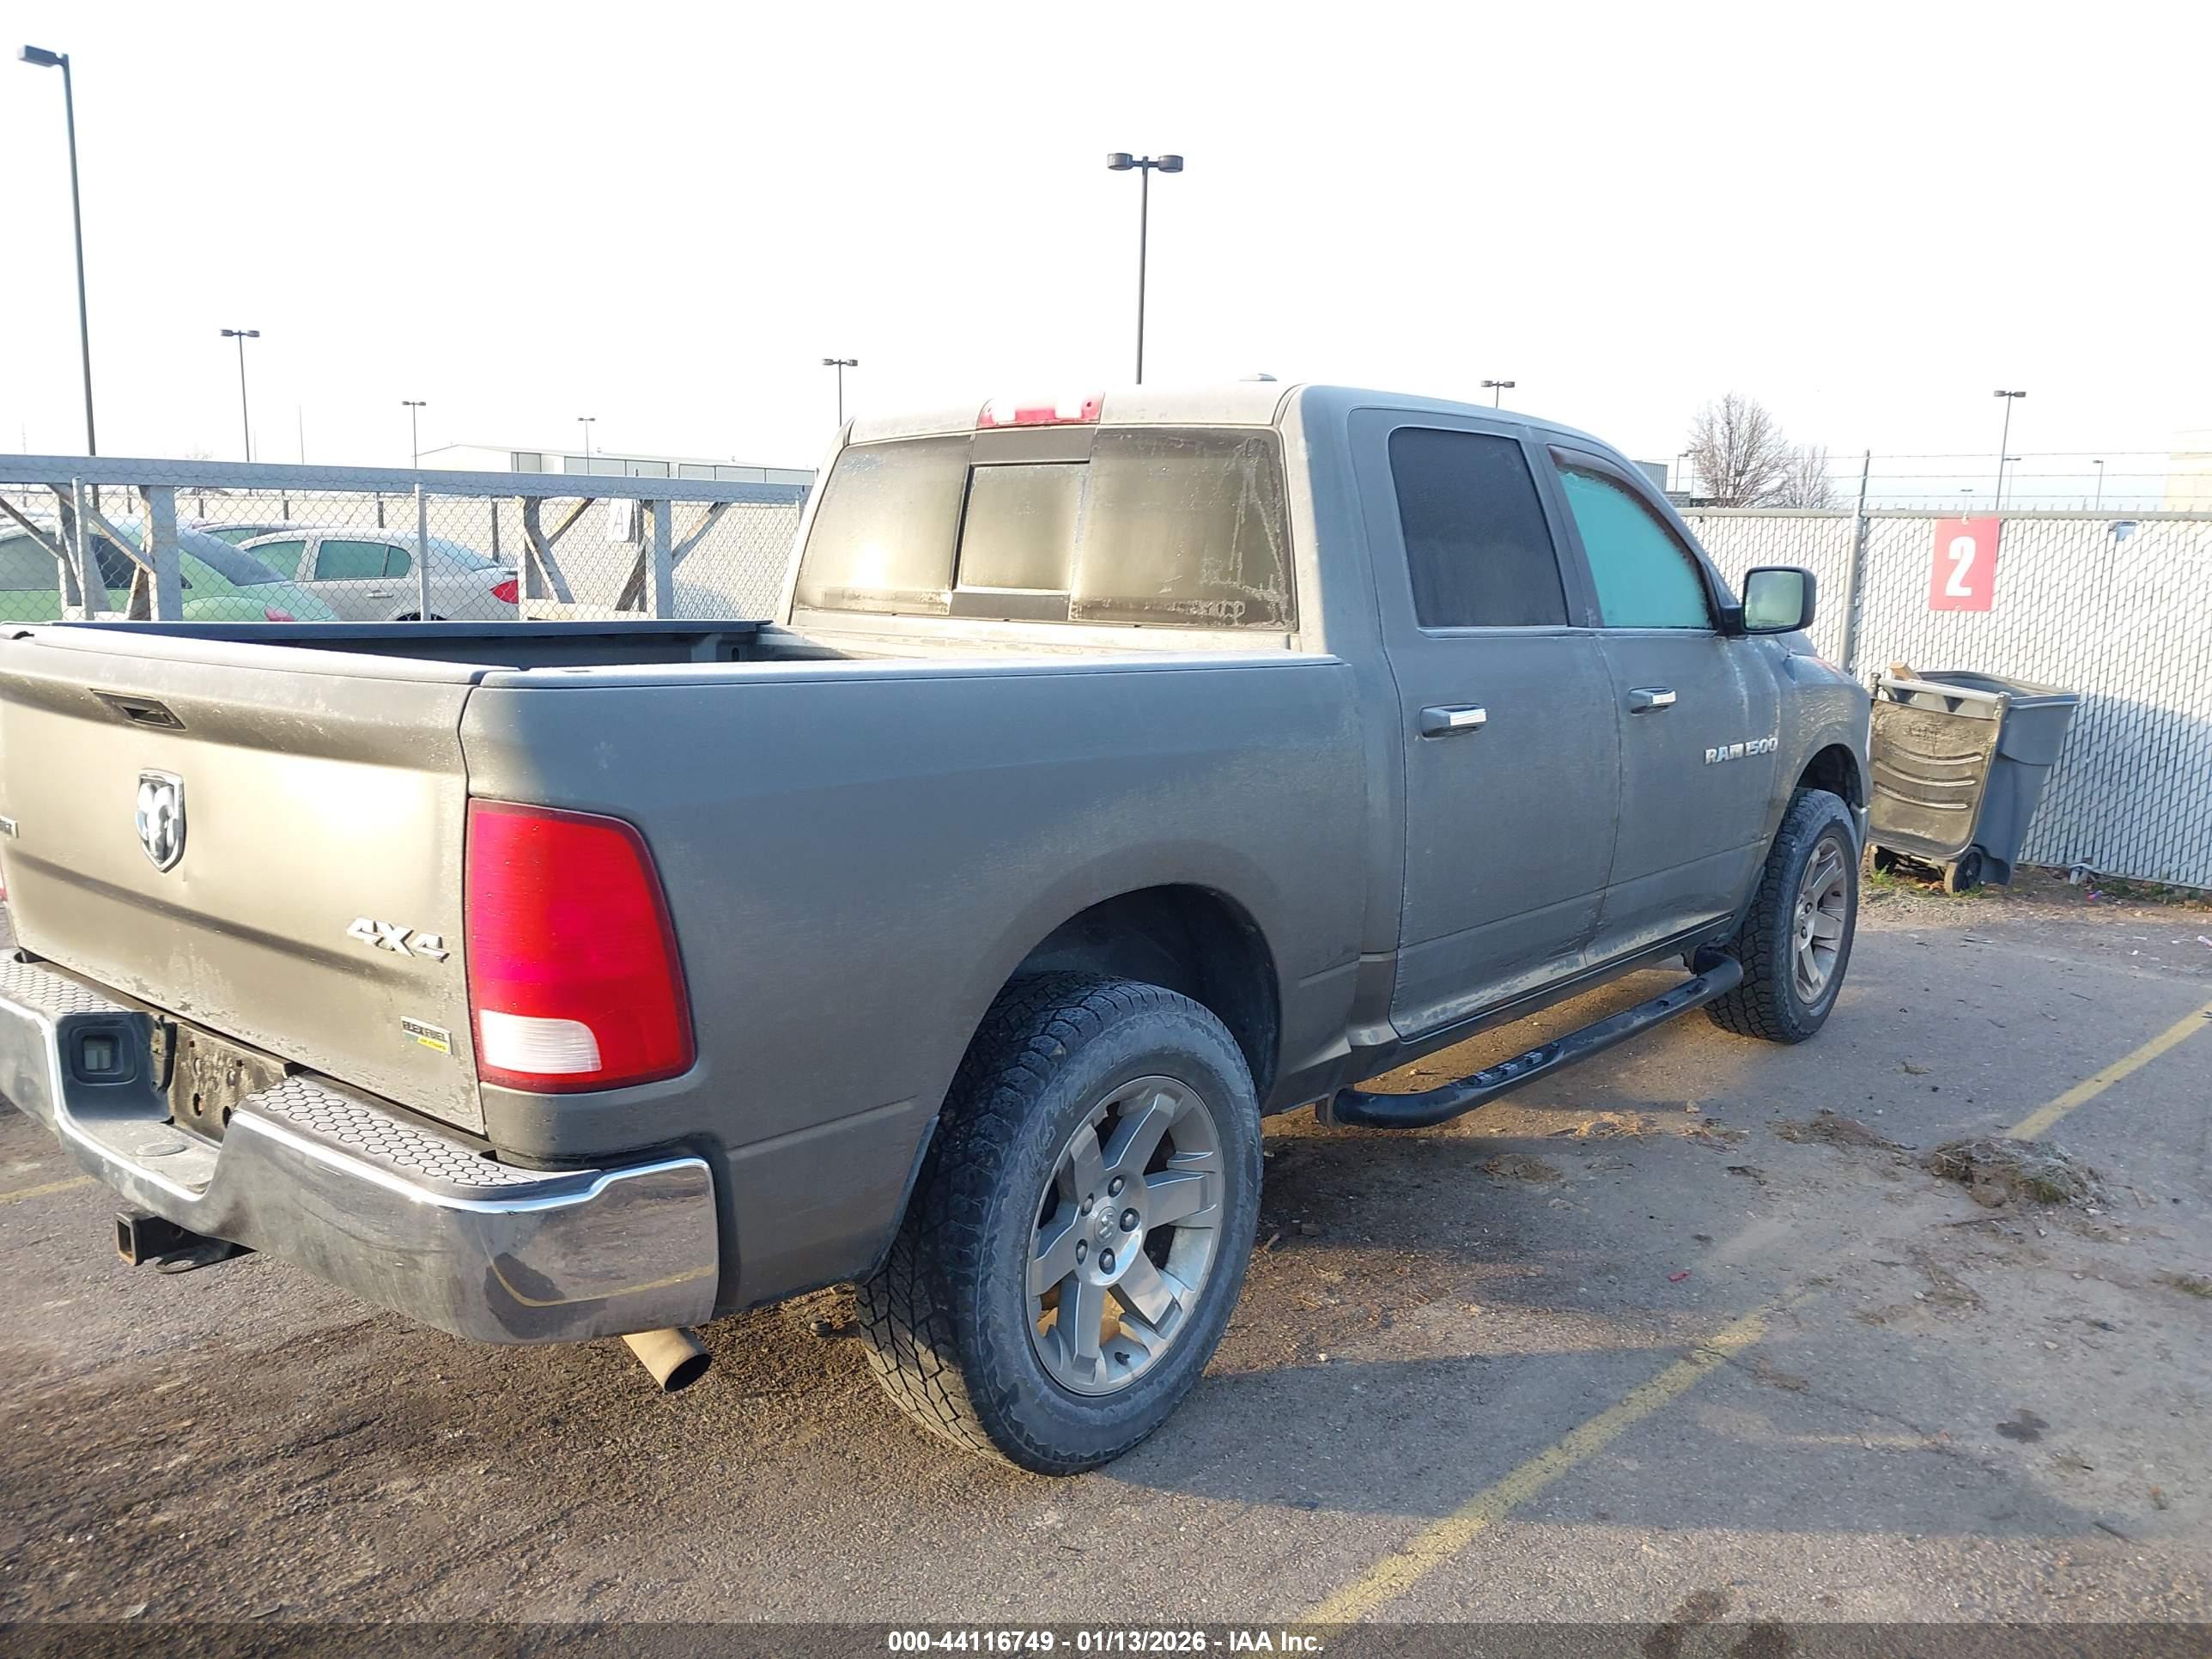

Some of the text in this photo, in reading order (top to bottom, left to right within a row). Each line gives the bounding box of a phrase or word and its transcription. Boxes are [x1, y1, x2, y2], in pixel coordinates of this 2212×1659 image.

[611, 505, 624, 535] A
[1945, 536, 1976, 598] 2
[1705, 737, 1779, 765] RAM 1500
